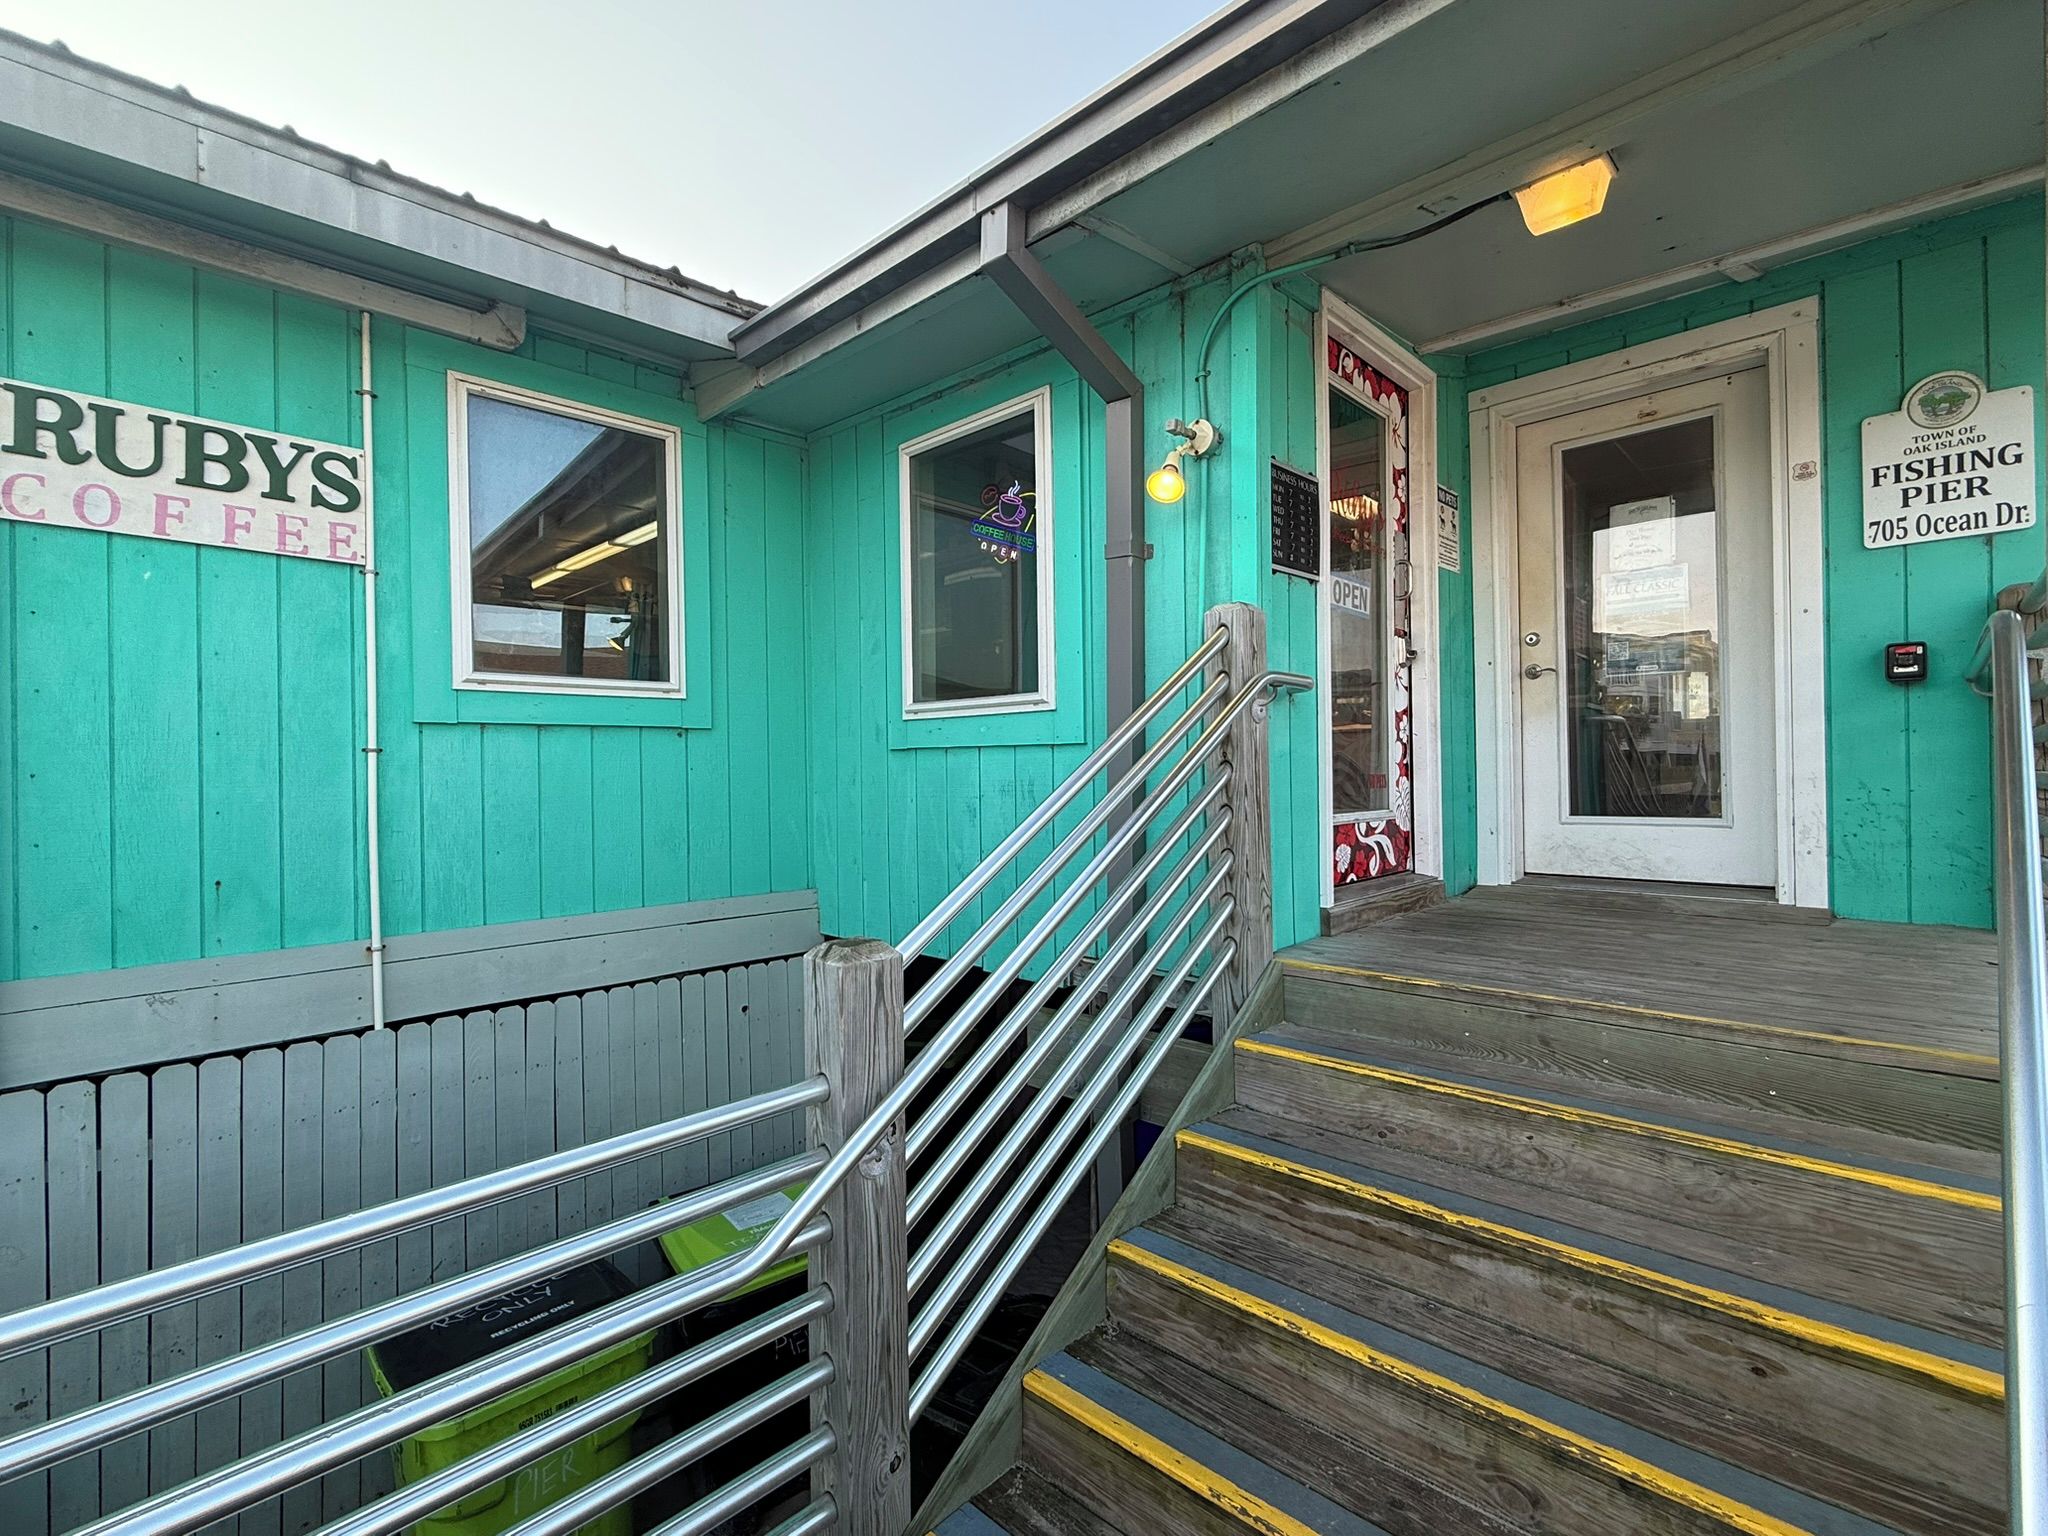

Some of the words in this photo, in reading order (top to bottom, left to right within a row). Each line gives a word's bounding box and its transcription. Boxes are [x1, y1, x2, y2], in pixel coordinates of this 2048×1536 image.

[1903, 445, 1932, 457] OAK
[1936, 433, 1987, 451] ISLAND
[1912, 429, 1954, 445] TOWN
[1958, 425, 1977, 437] OF
[0, 382, 361, 513] RUBYS
[1870, 442, 2024, 488] FISHING
[1272, 468, 1297, 487] BUSINESS
[1298, 480, 1318, 495] HOURS
[1900, 475, 1992, 509] PIER
[1272, 493, 1282, 504] TUE
[1272, 504, 1285, 516] WED
[1438, 489, 1446, 502] NO
[1446, 492, 1457, 508] PETS
[1, 472, 358, 562] COFFEE
[1272, 515, 1284, 527] THU
[1868, 515, 1908, 544] 705
[1915, 510, 1988, 538] Ocean
[973, 523, 1005, 540] COFFEE
[1005, 532, 1034, 548] HOUSE
[1272, 526, 1281, 536] FRI
[1272, 538, 1282, 547] SAT
[980, 541, 1017, 560] OPEN
[1272, 549, 1283, 559] SUN
[1333, 579, 1368, 612] OPEN
[1633, 579, 1681, 594] CLASSIC
[482, 1286, 552, 1322] ONLY
[490, 1311, 549, 1339] RECYCLING
[550, 1299, 576, 1314] ONLY
[514, 1447, 582, 1516] PIER
